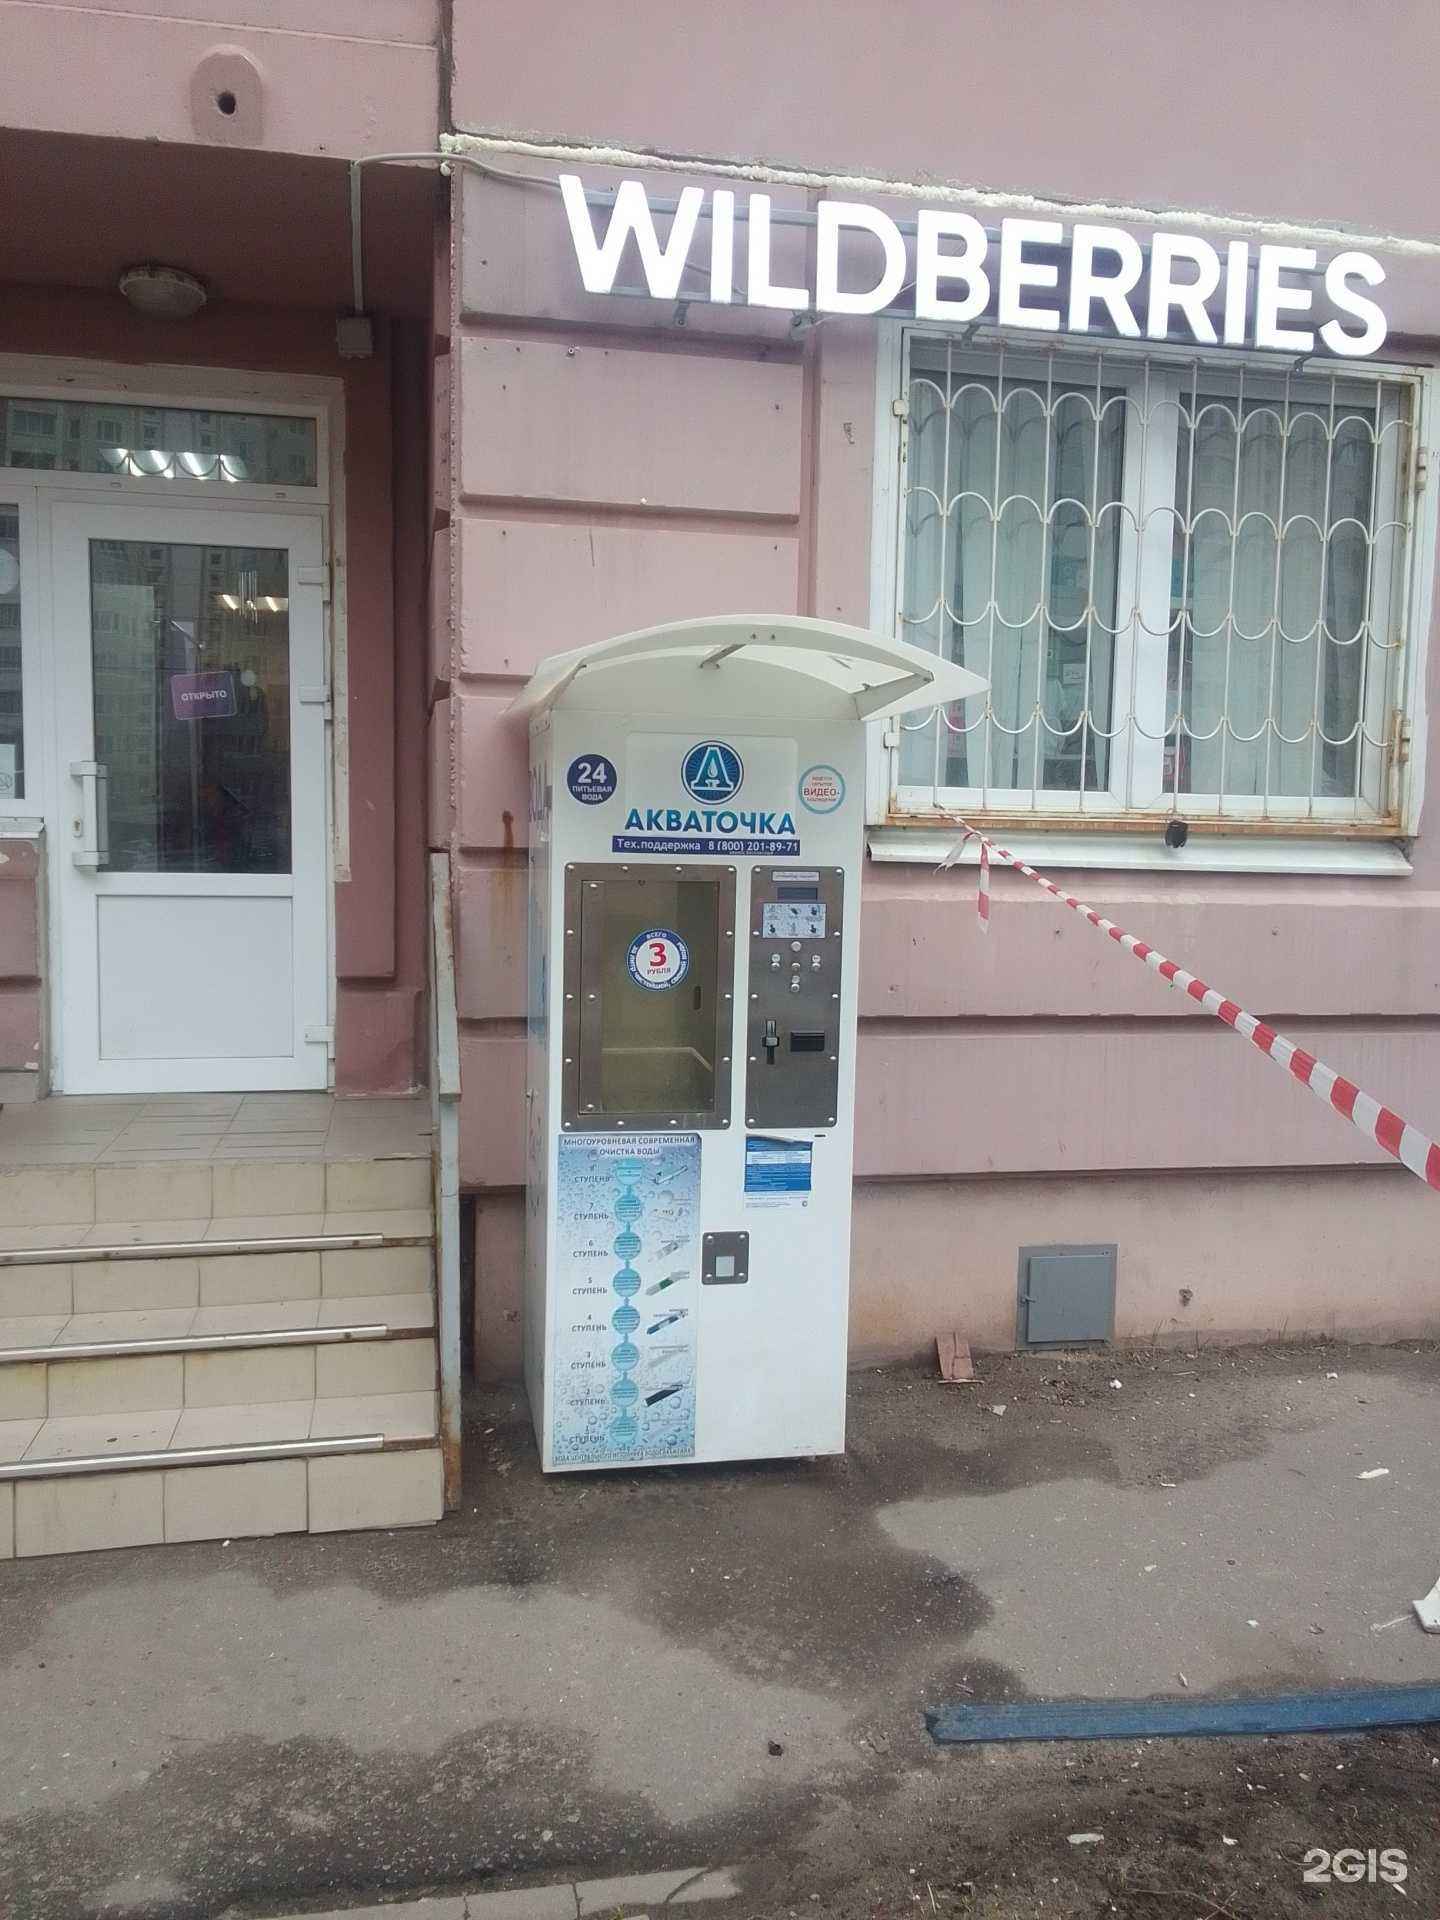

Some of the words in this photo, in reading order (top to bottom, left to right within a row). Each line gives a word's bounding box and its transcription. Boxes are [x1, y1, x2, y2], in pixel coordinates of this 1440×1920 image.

[560, 175, 1388, 356] WILDBERRIES
[180, 689, 228, 701] ОТКРЫТО
[577, 762, 607, 784] 24
[572, 785, 613, 793] ПИТЬЕВАЯ
[581, 793, 604, 801] ВОДА
[624, 808, 796, 835] АКВАТОЧКА
[708, 840, 715, 850] 8
[717, 840, 744, 851] (800)
[747, 841, 798, 851] 201-89-71
[648, 942, 667, 967] 3
[563, 1138, 636, 1146] МНОГОУРОВНЕВАЯ
[638, 1137, 695, 1145] СОВРЕМЕННАЯ
[599, 1148, 636, 1156] ОЧИСТКА
[637, 1148, 660, 1156] ВОДЫ
[574, 1213, 609, 1221] СТУПЕНЬ
[572, 1250, 609, 1258] СТУПЕНЬ
[572, 1287, 608, 1295] СТУПЕНЬ
[571, 1325, 607, 1333] СТУПЕНЬ
[570, 1360, 607, 1370] СТУПЕНЬ
[569, 1399, 606, 1407] СТУПЕНЬ
